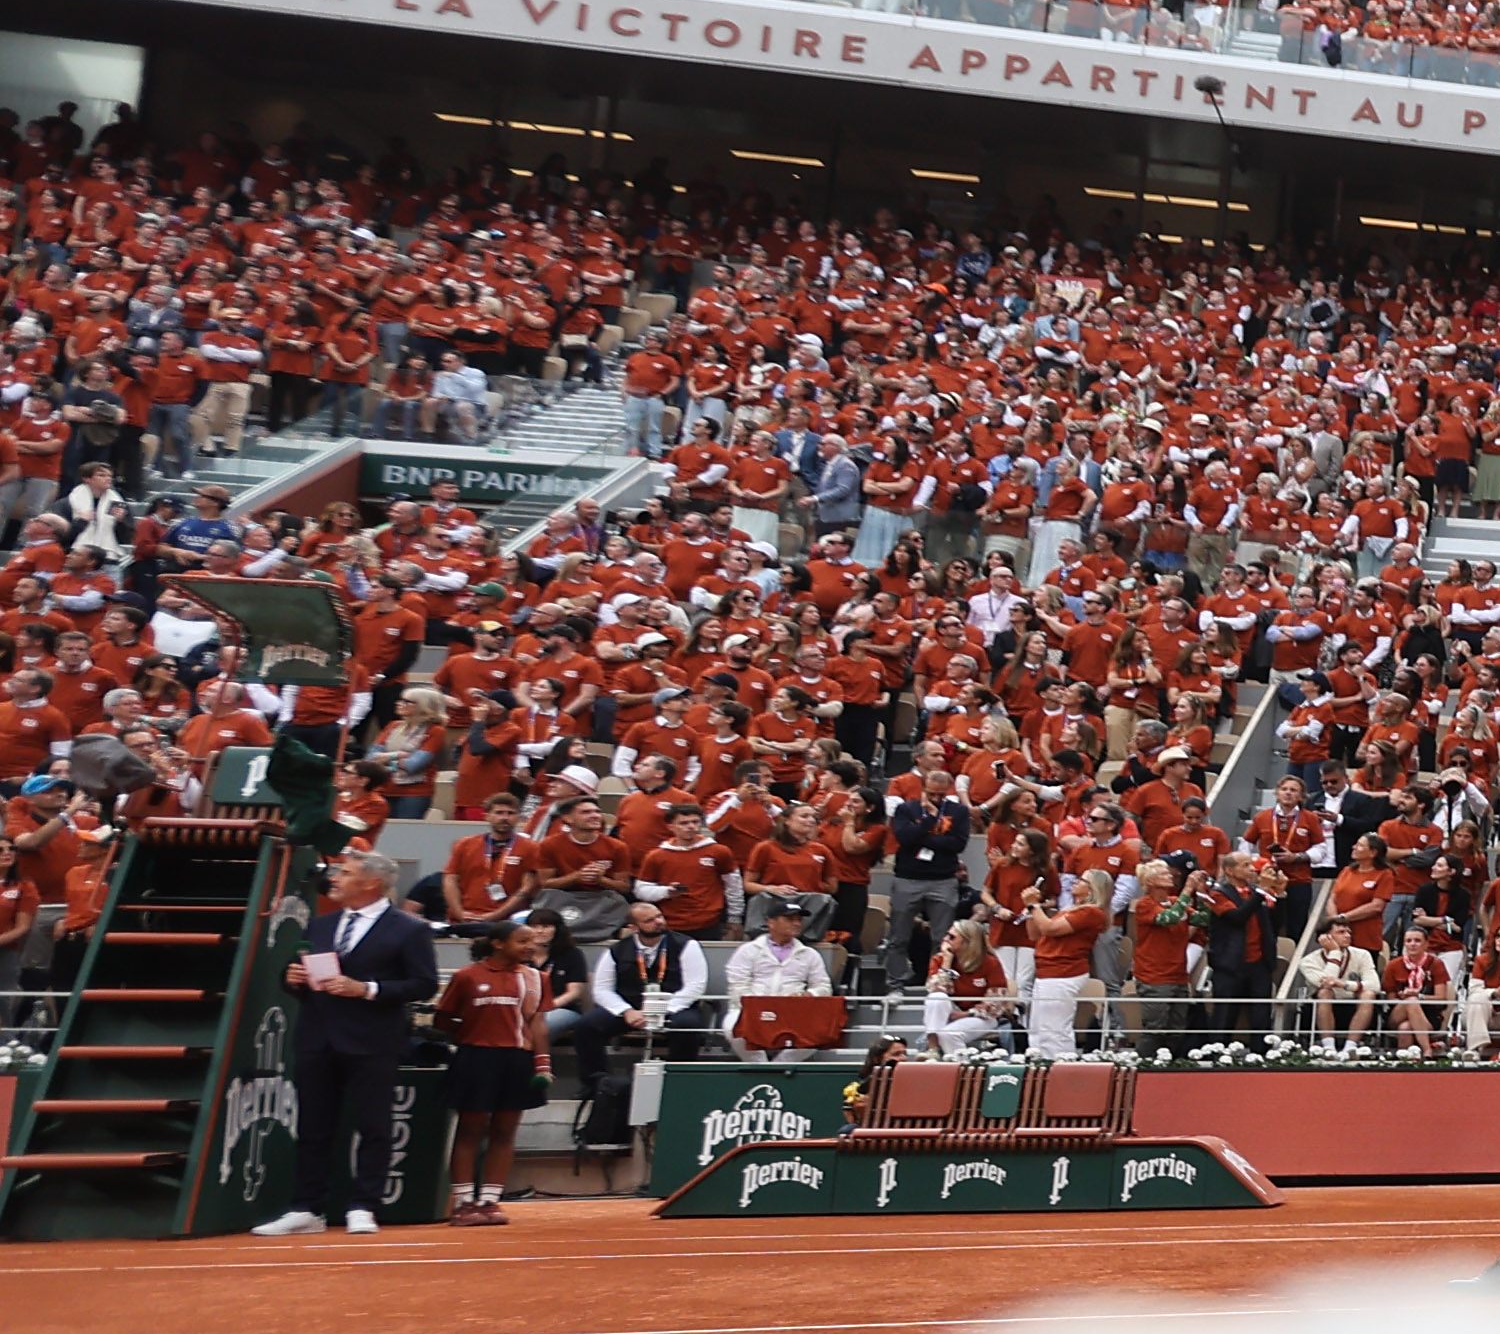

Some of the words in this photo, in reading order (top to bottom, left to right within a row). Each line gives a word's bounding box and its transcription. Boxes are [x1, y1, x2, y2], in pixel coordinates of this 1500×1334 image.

[1352, 97, 1424, 128] AU
[697, 1101, 812, 1166] perrier
[738, 1155, 824, 1208] perrier
[939, 1158, 1008, 1199] perrier
[1121, 1152, 1198, 1203] perrier
